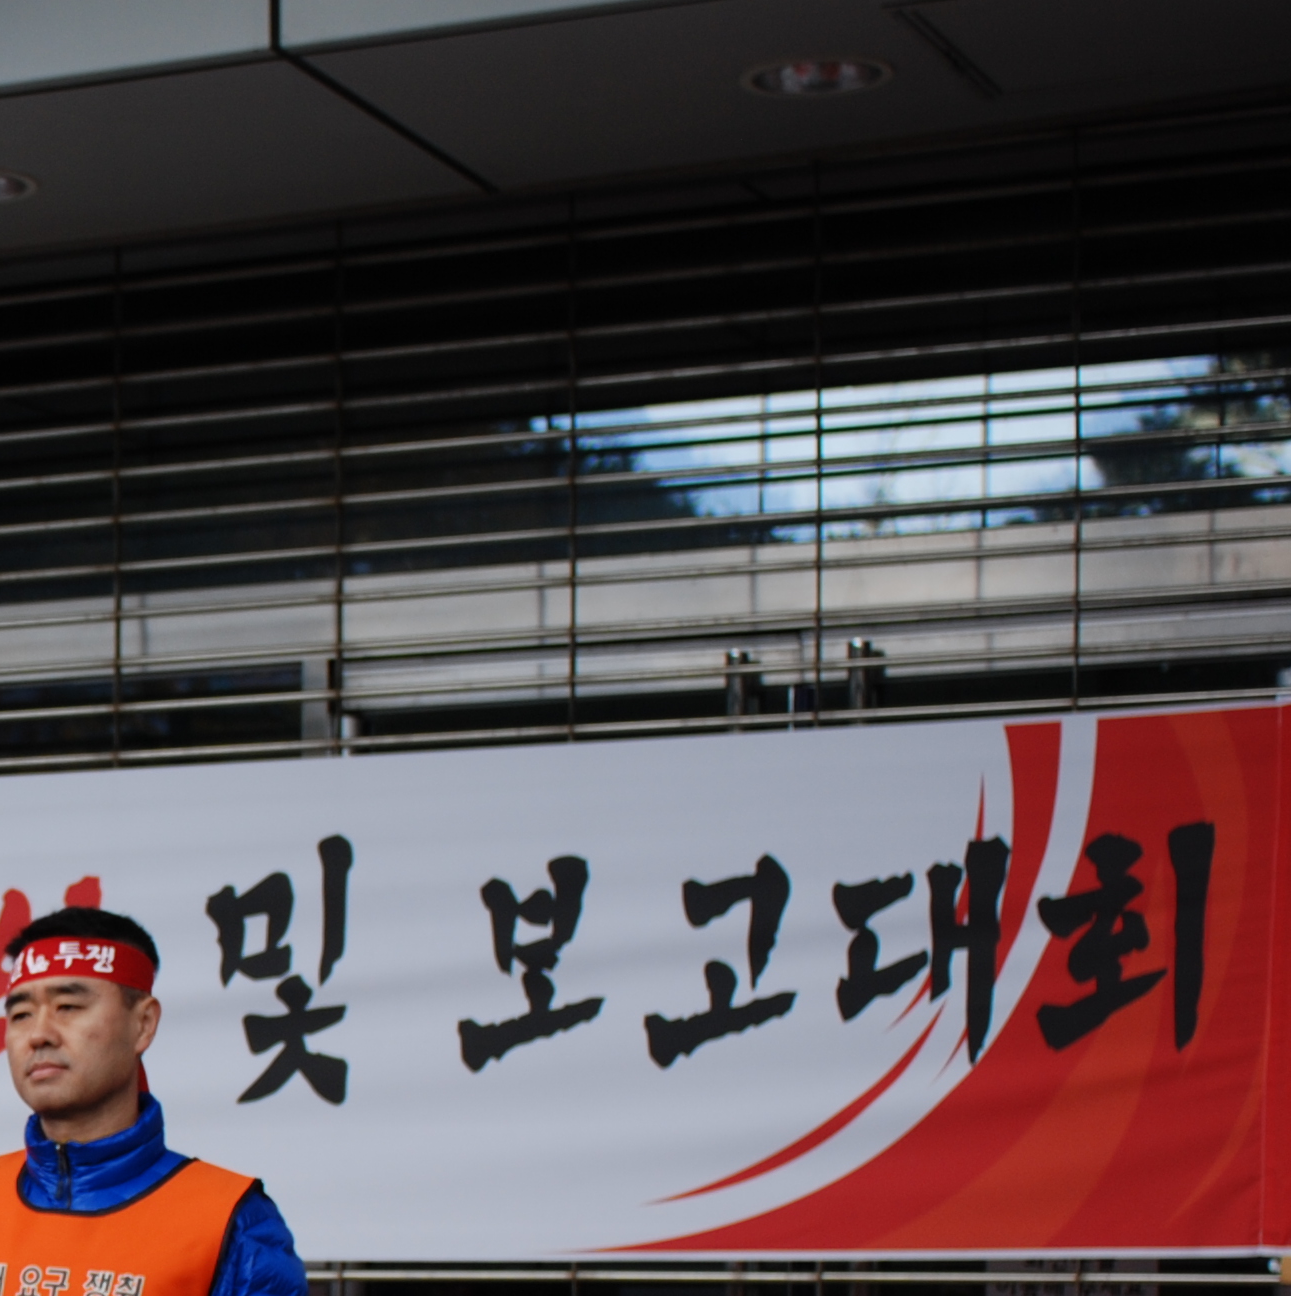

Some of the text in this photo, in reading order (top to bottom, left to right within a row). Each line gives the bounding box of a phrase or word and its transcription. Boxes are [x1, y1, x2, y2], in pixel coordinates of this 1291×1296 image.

[53, 940, 116, 974] 투쟁
[206, 834, 354, 1106] 및
[458, 820, 1216, 1073] 보고대회
